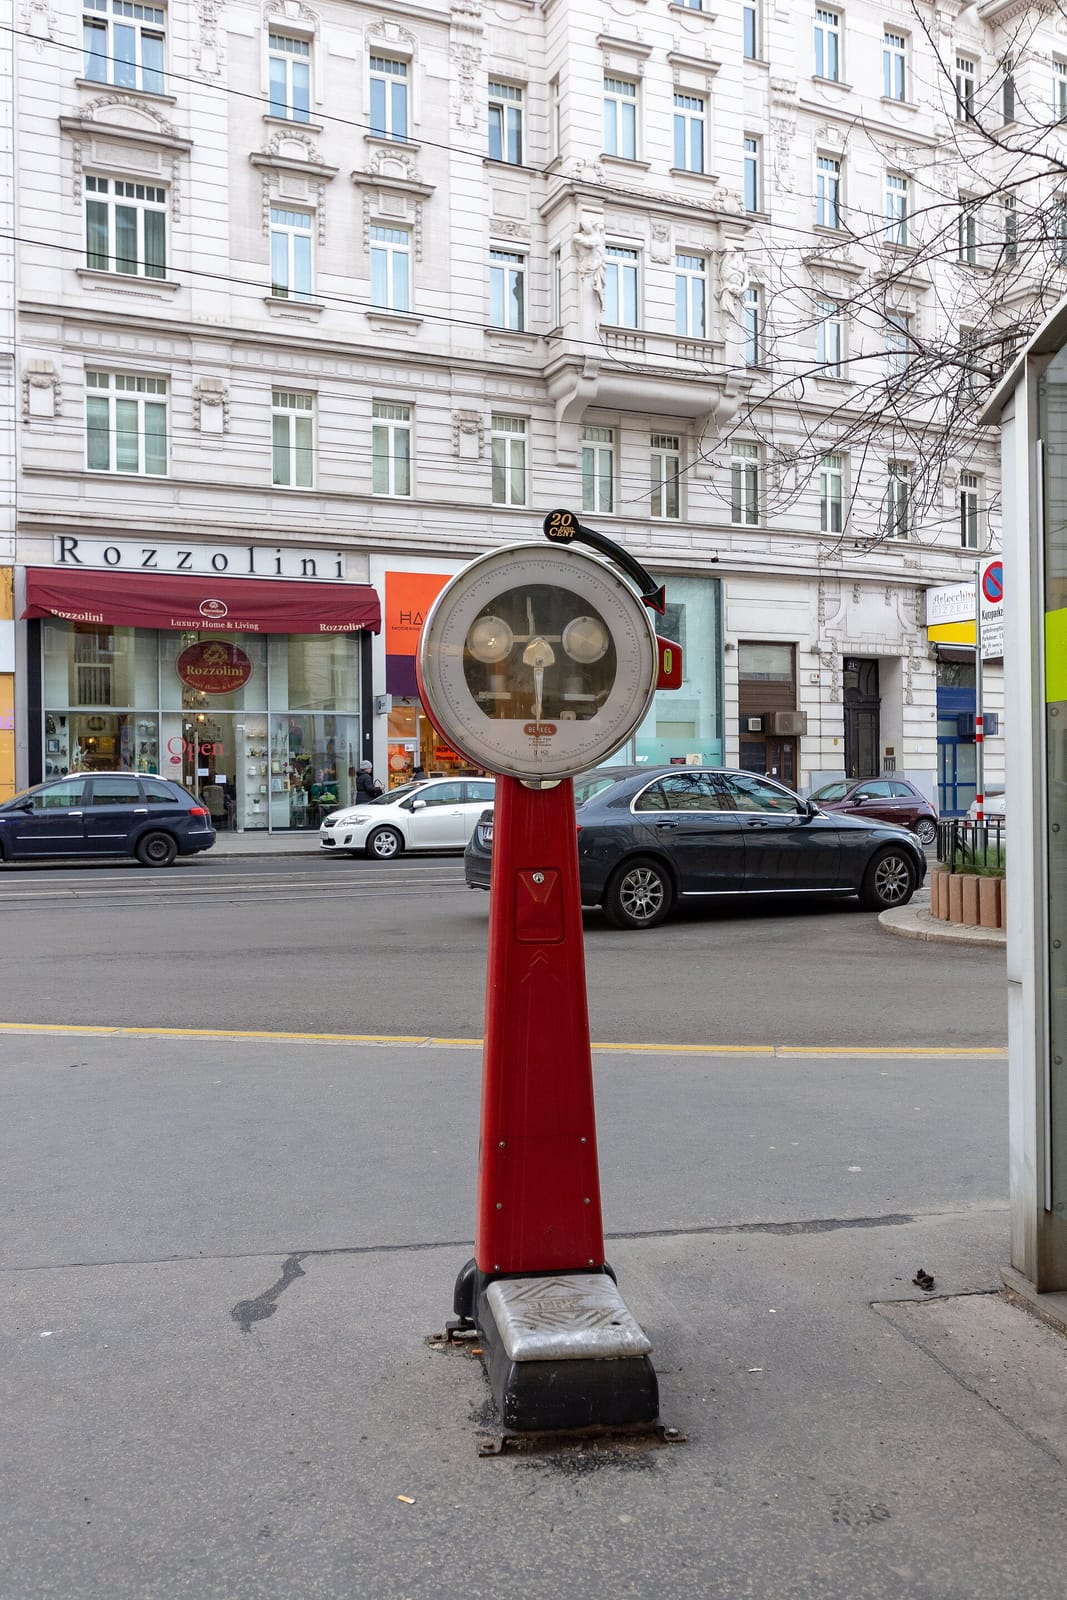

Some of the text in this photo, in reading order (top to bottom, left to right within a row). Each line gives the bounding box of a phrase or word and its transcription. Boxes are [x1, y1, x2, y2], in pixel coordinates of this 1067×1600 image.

[550, 513, 572, 526] 20
[549, 527, 576, 538] CENT
[56, 535, 345, 578] Rozzolini
[170, 618, 260, 630] Luxury Home & Living
[186, 664, 244, 676] Rozzolini
[528, 726, 553, 734] BEKEL
[167, 736, 225, 763] Open
